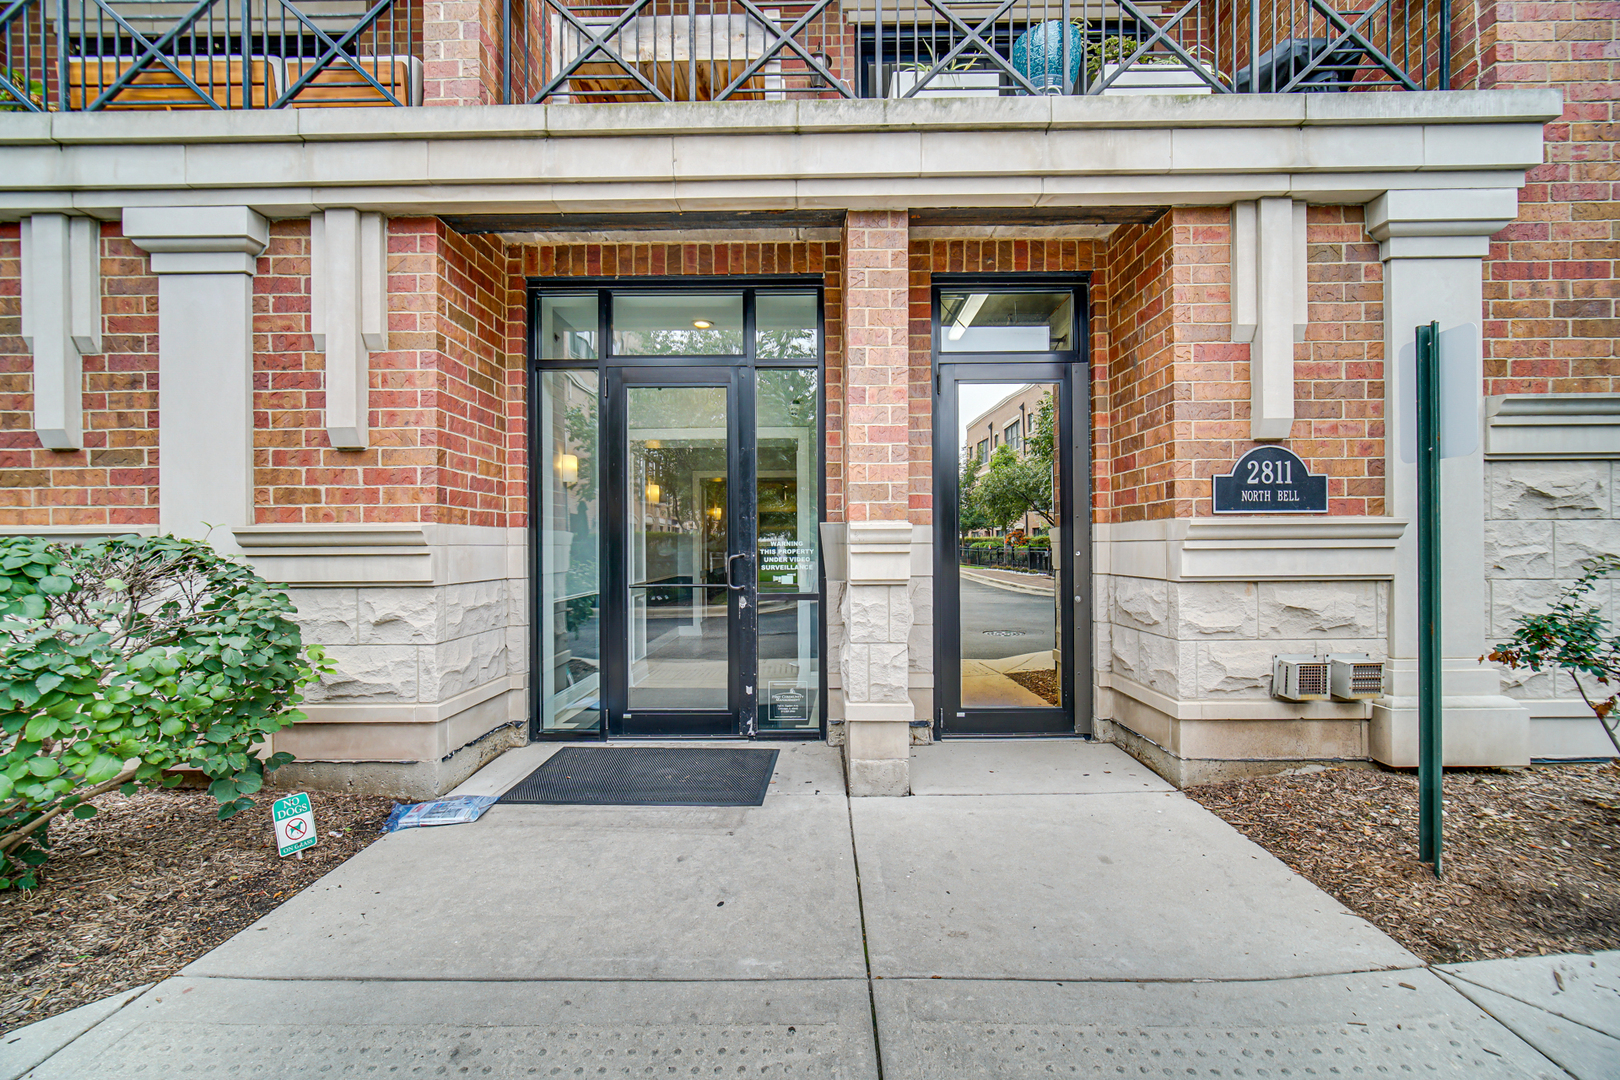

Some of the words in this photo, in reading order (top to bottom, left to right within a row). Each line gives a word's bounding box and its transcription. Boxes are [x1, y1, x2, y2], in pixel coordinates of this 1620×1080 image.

[1247, 460, 1292, 484] 2811
[1241, 490, 1271, 501] NORTH
[1277, 490, 1300, 501] BELL
[282, 797, 300, 809] NO
[277, 803, 308, 820] DOGS
[283, 846, 294, 854] ON
[294, 839, 313, 849] GRASS
